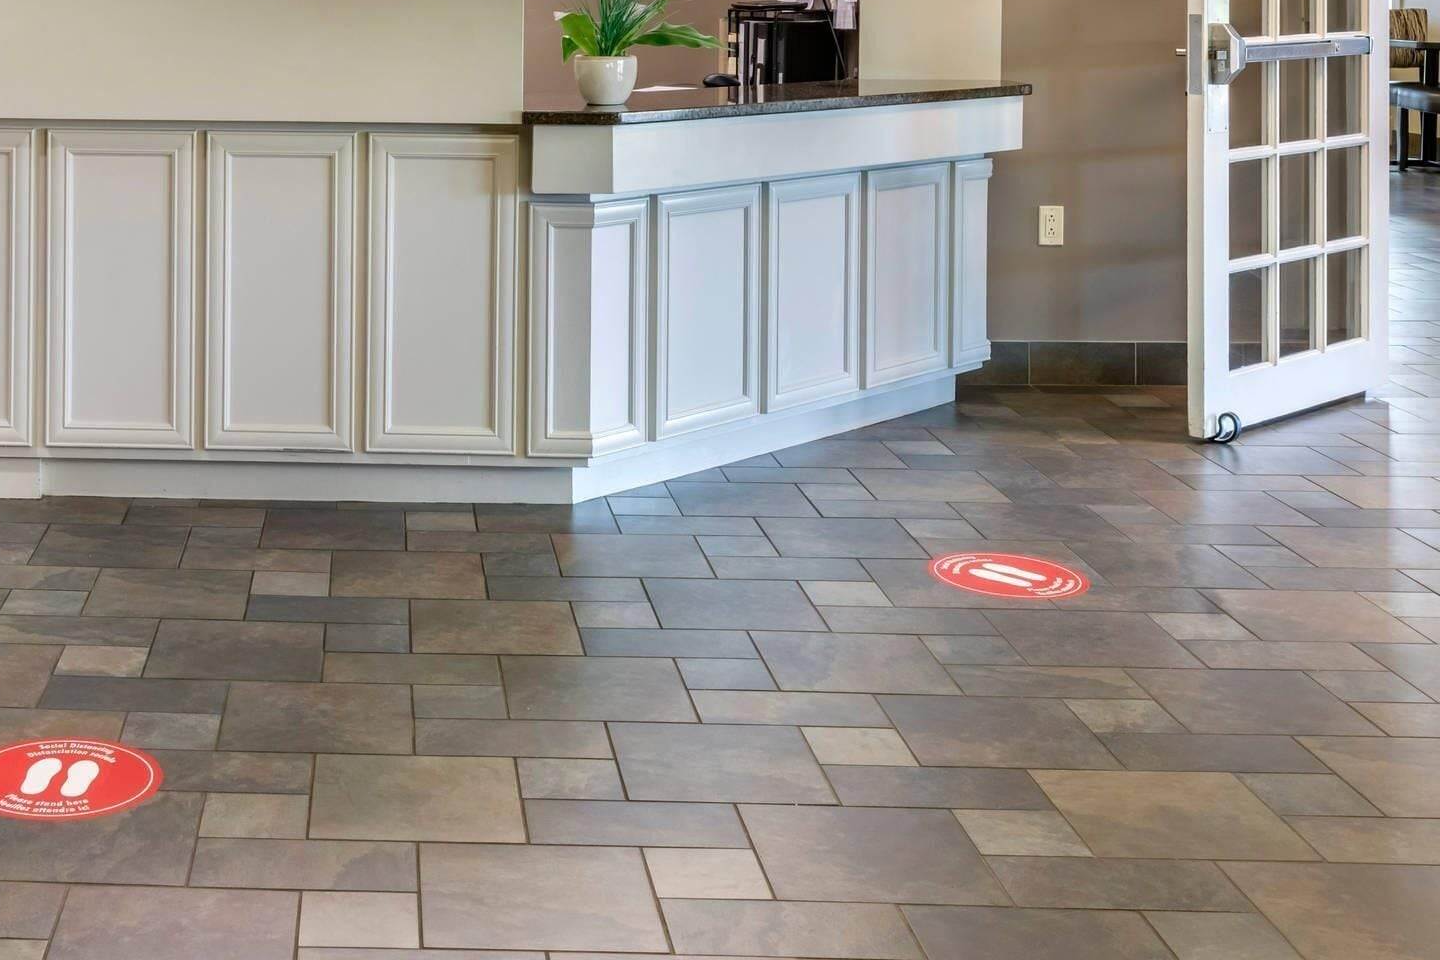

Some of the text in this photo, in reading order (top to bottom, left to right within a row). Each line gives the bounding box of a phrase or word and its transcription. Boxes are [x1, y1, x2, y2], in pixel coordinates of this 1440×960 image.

[38, 742, 67, 751] Social
[35, 799, 63, 807] stand
[66, 798, 89, 806] here
